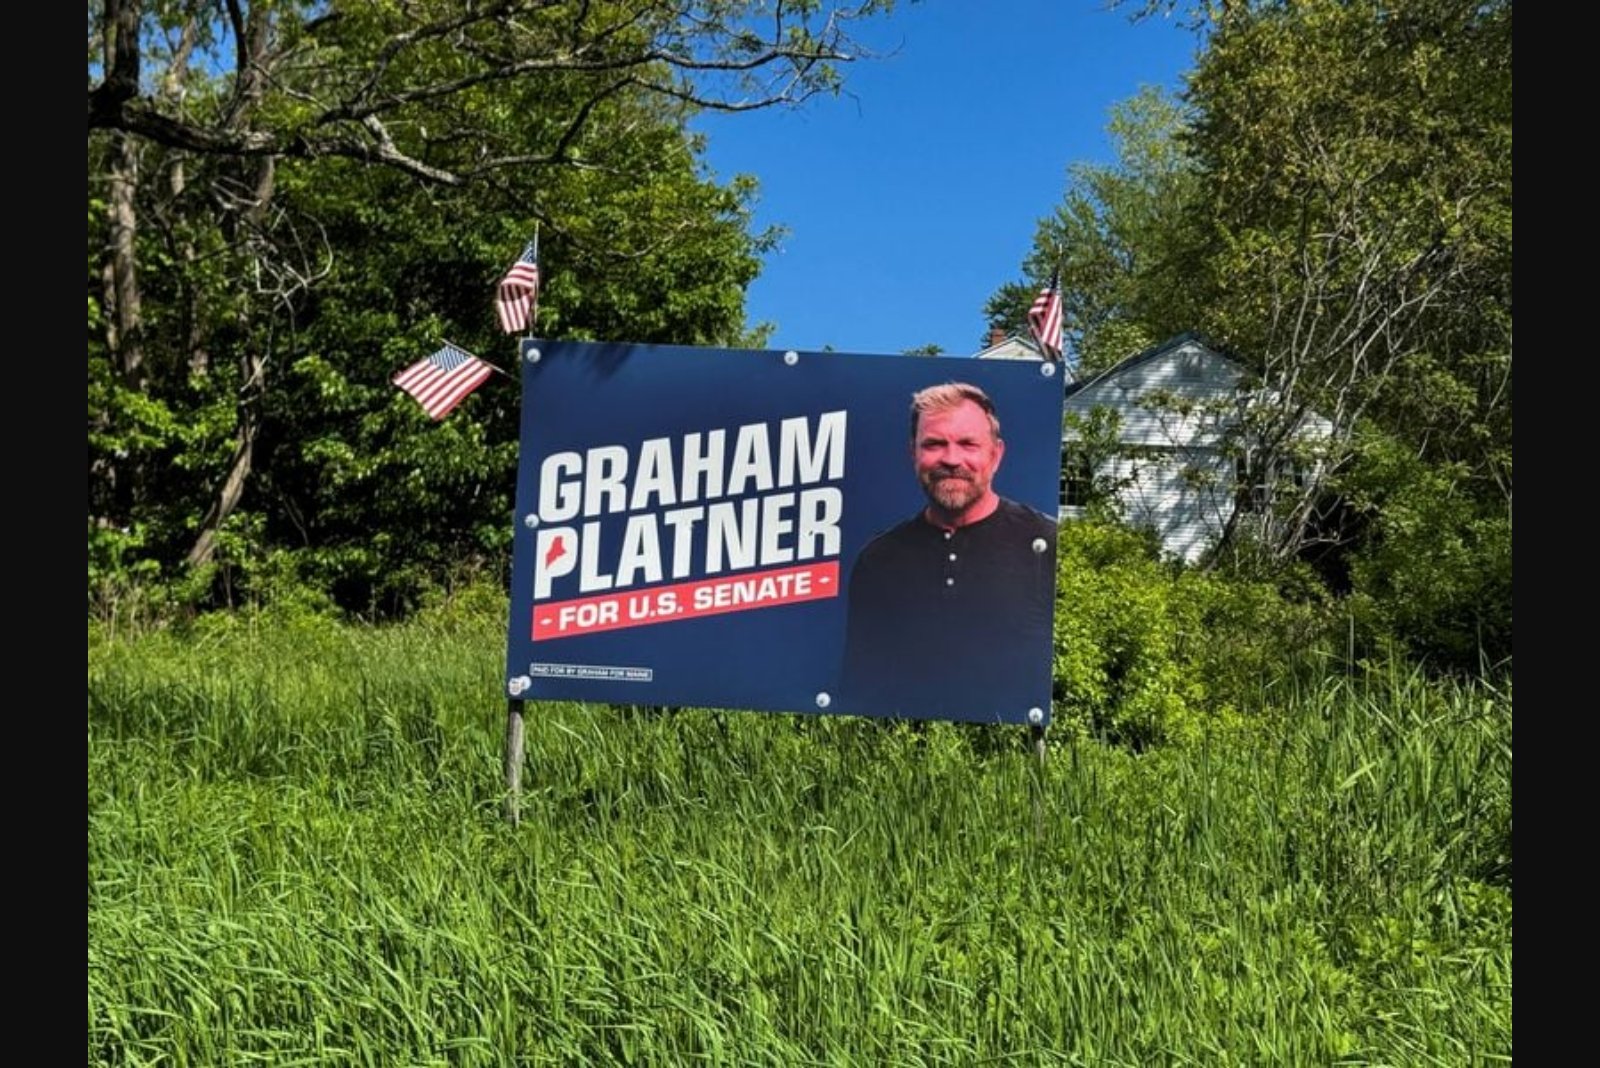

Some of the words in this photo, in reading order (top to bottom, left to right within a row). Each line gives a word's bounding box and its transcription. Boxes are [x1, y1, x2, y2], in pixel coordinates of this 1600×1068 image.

[538, 410, 848, 522] GRAHAM
[534, 487, 843, 600] PLATNER
[558, 600, 619, 632] FOR
[629, 592, 684, 620] U.S.
[693, 571, 812, 611] SENATE
[550, 666, 565, 675] FOR
[567, 667, 577, 676] BY
[610, 669, 625, 679] FOR
